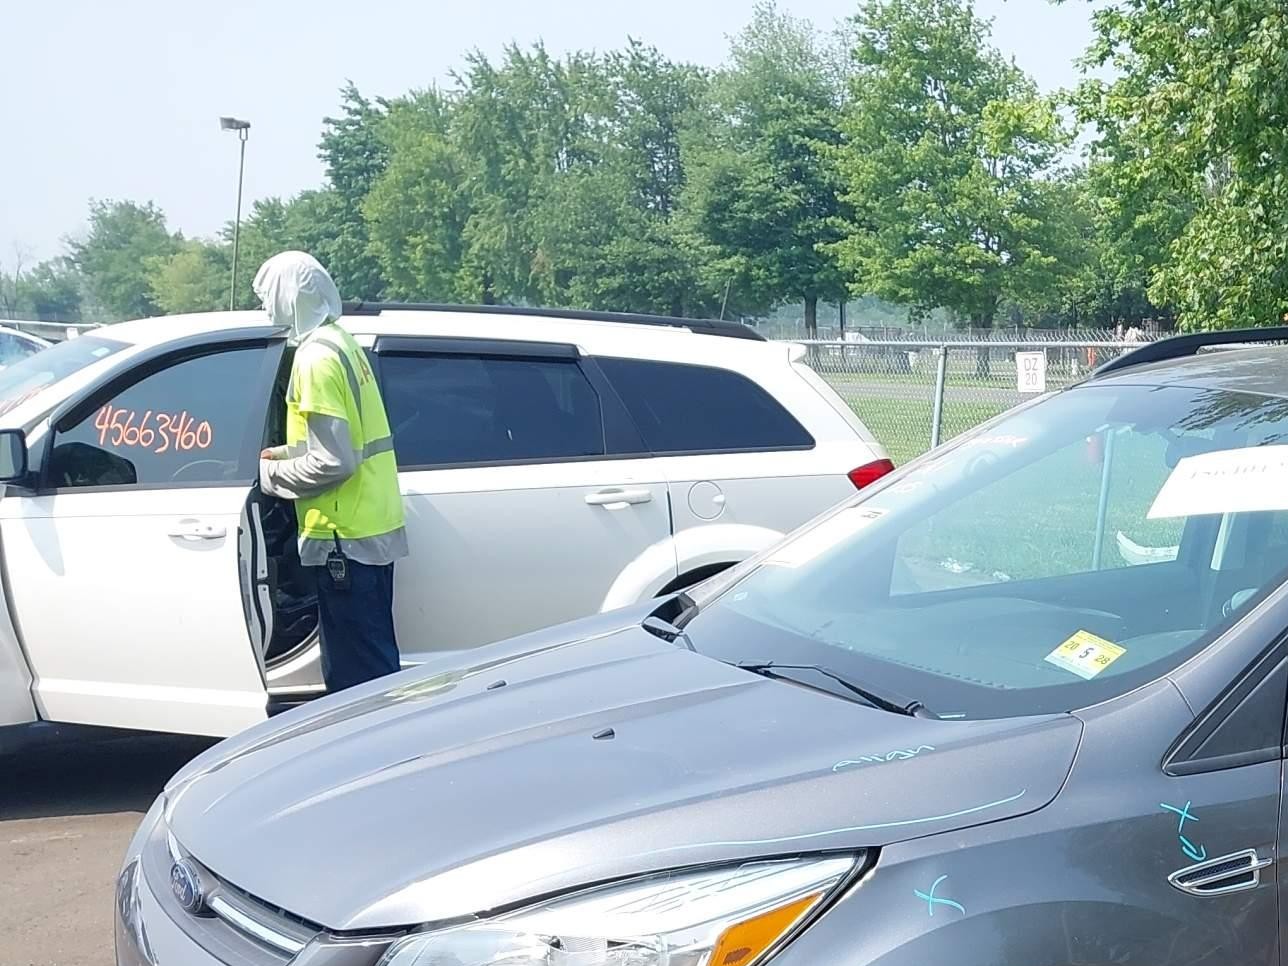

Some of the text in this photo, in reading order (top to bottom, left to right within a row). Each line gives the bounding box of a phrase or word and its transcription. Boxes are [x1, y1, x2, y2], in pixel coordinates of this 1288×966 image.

[1025, 373, 1038, 385] 20
[95, 405, 212, 453] 45663460
[1064, 640, 1080, 651] 20
[1095, 654, 1111, 665] 28
